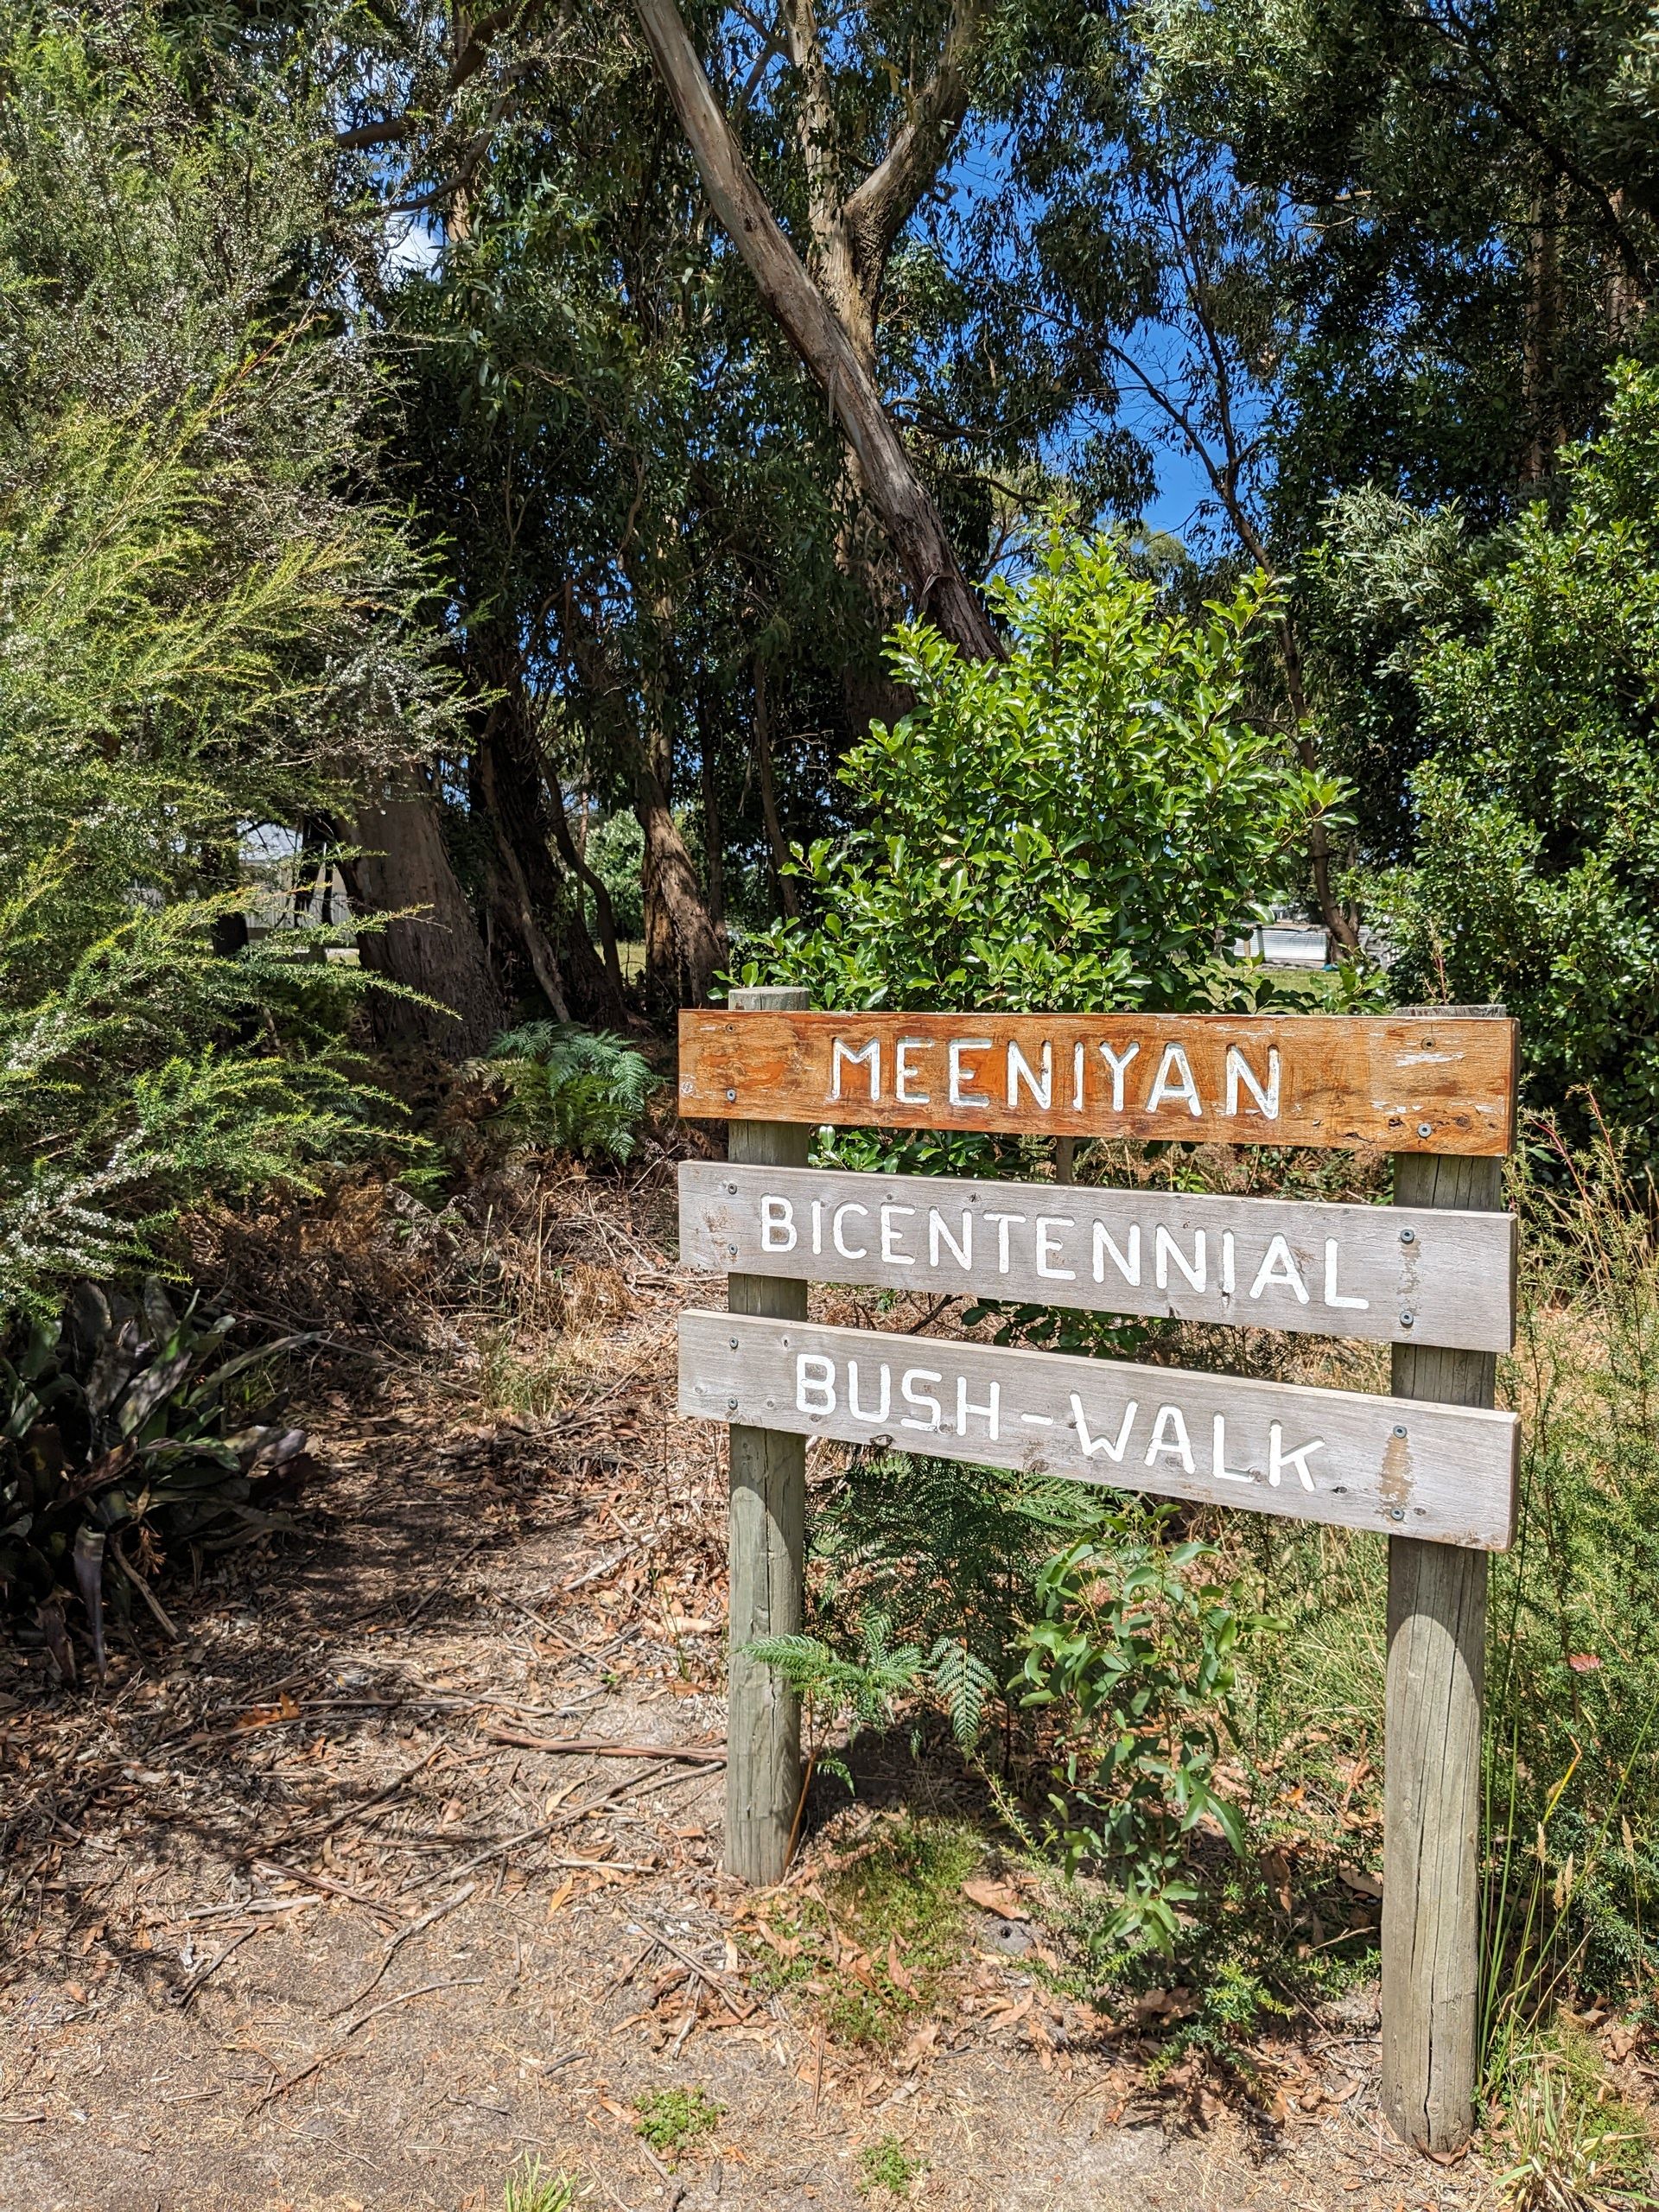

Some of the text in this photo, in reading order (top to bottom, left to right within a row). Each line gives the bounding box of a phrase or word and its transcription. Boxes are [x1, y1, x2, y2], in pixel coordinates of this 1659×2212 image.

[830, 1037, 1281, 1120] MEENIYAN
[760, 1194, 1370, 1309] BICENTENNIAL
[796, 1353, 1325, 1492] BUSH-WALK
